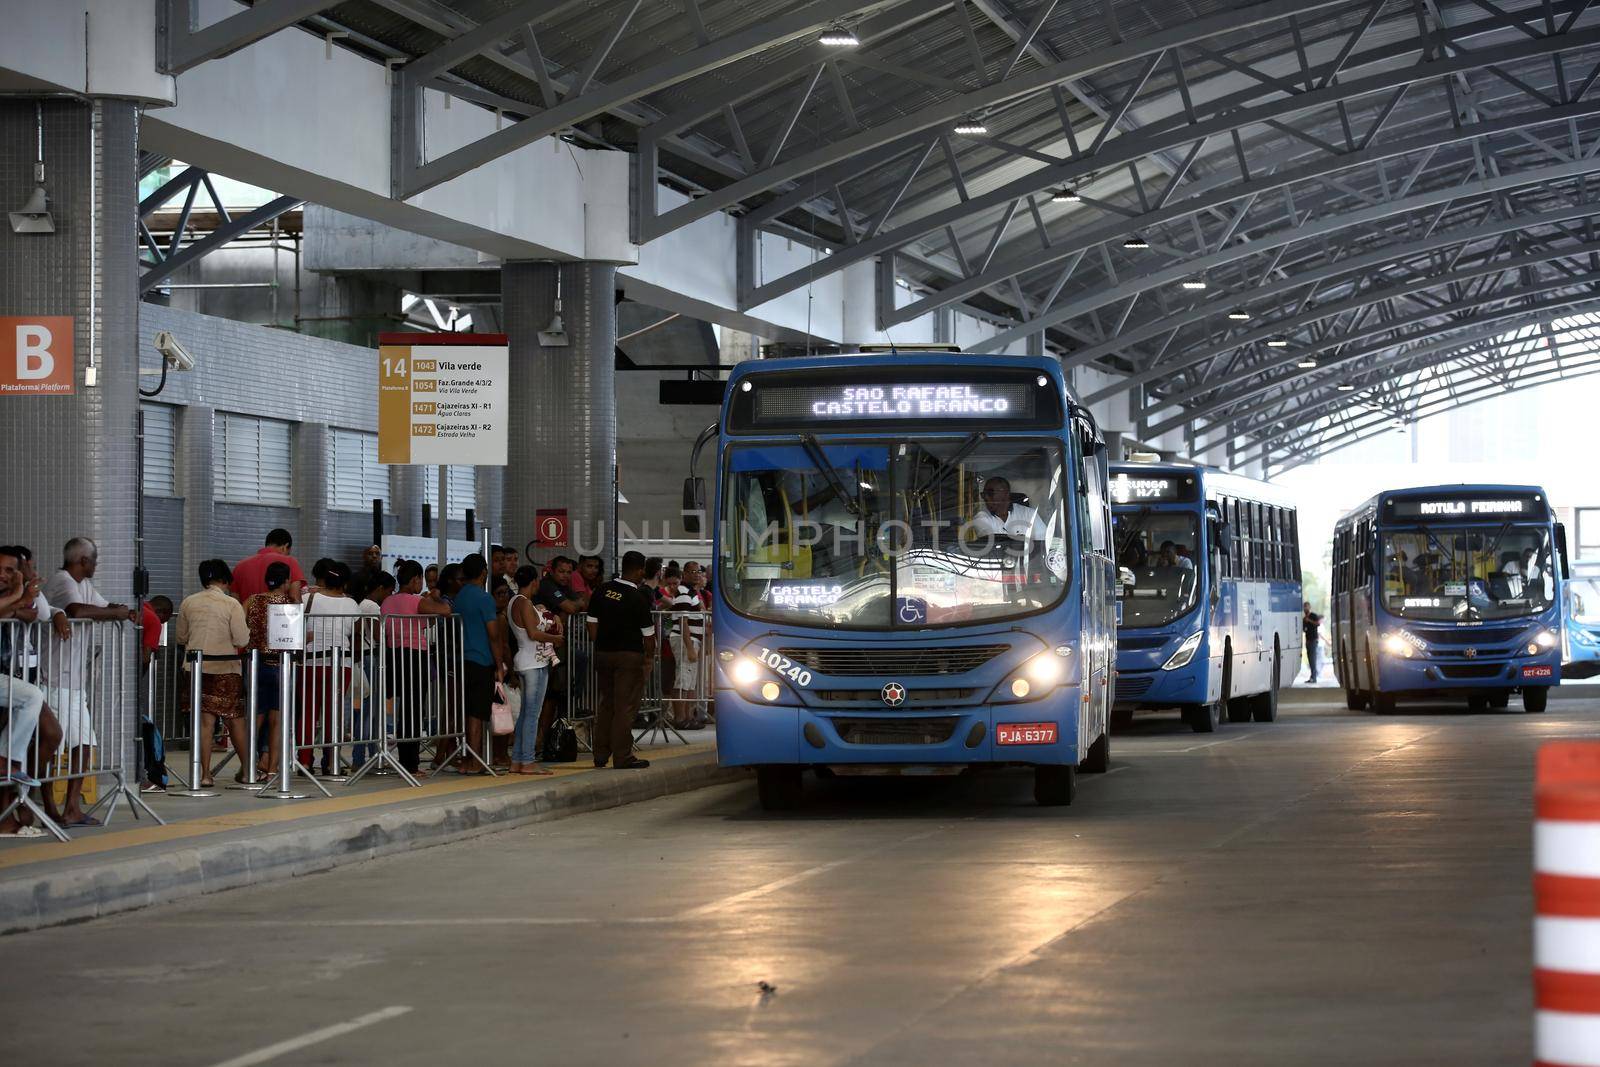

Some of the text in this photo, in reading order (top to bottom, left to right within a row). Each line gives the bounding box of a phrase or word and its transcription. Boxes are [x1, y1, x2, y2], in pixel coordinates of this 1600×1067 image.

[16, 325, 54, 379] B
[382, 358, 407, 378] 14
[416, 362, 482, 371] 1043 Vila verde
[414, 381, 434, 390] 1054
[843, 386, 979, 400] SAO RAFAEL
[414, 404, 433, 412] 1471
[813, 399, 1008, 414] CASTELO BRANCO
[1421, 502, 1466, 514] ROTULA
[605, 589, 622, 601] 222
[771, 586, 842, 596] CASTELO
[774, 595, 838, 605] BRANCO
[758, 647, 812, 687] 10240
[1000, 730, 1055, 742] PJA-6377
